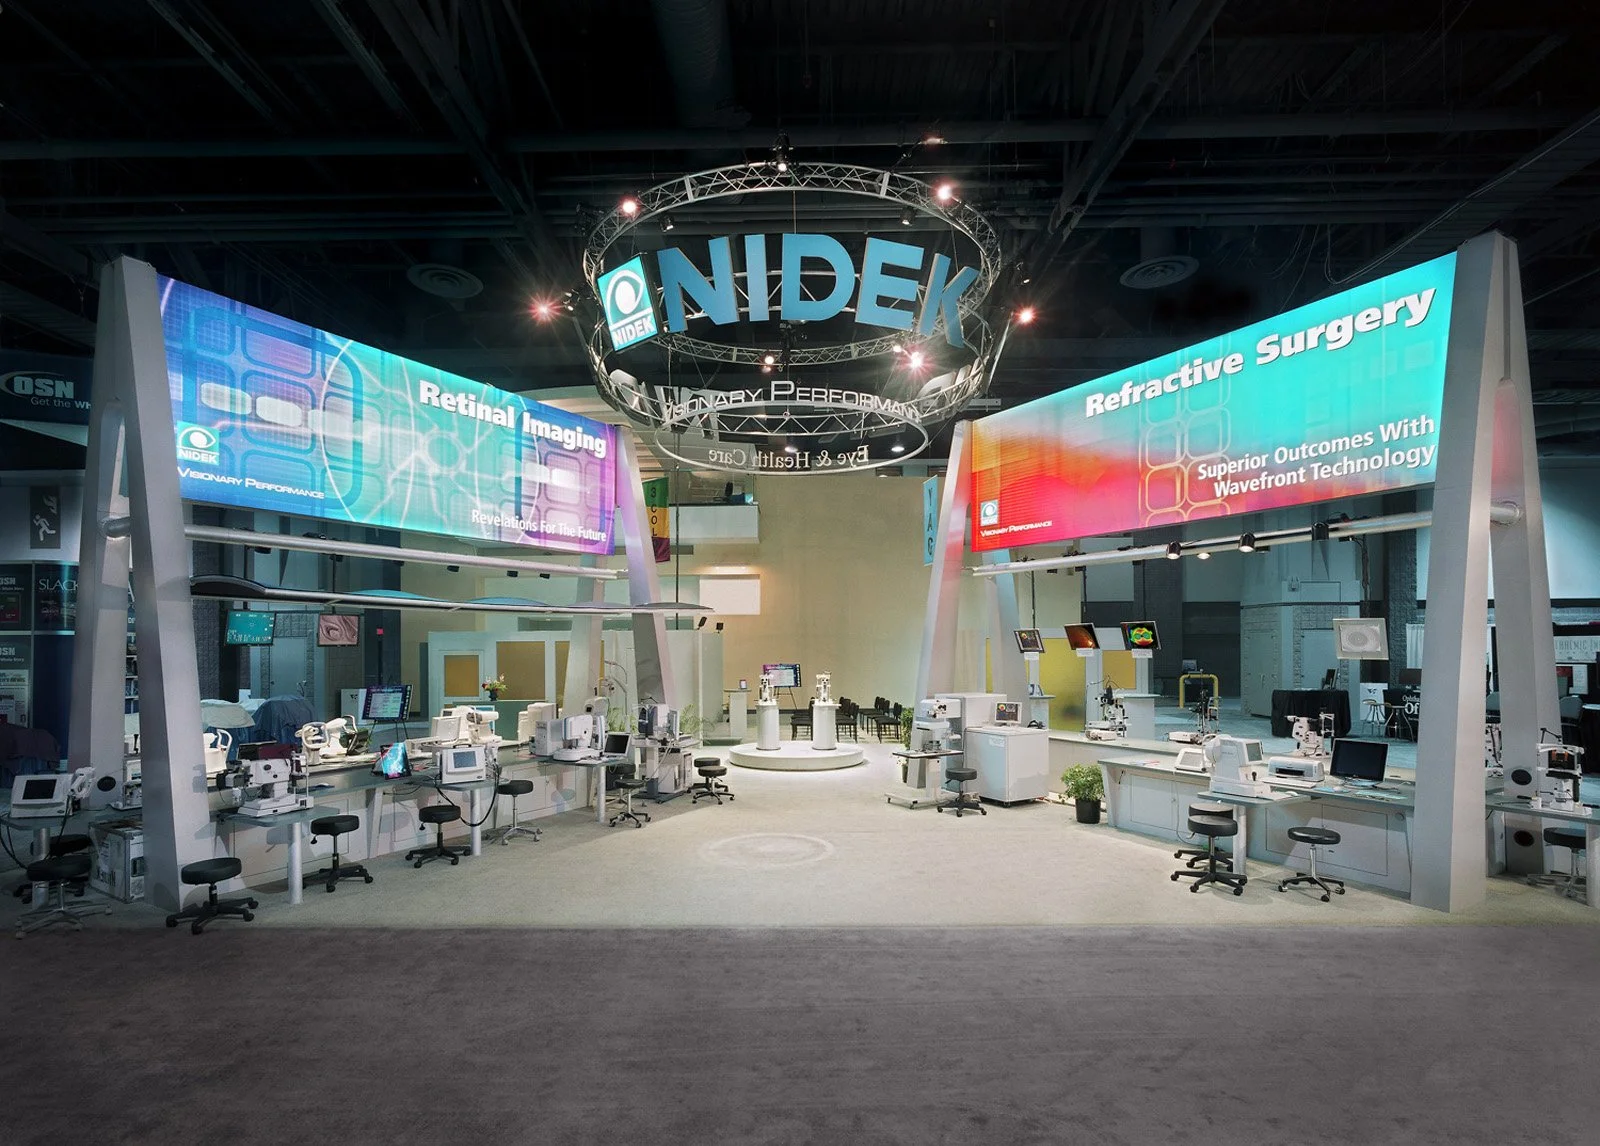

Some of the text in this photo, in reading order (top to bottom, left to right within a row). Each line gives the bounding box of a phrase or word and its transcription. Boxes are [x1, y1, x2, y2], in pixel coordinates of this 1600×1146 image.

[657, 233, 980, 348] NIDEK
[610, 315, 655, 349] NIDEK
[1085, 287, 1437, 418] Refractive Surgery
[13, 376, 75, 399] OSN
[30, 396, 51, 407] Get
[53, 399, 72, 408] the
[419, 380, 607, 459] Retinal Imaging
[180, 449, 218, 465] NIDEK
[1198, 414, 1436, 483] Superior Outcomes With
[177, 466, 325, 499] VISIONARY PERFORMANCE
[1213, 444, 1436, 498] Wavefront Technology
[472, 509, 607, 542] Revelations For The Future
